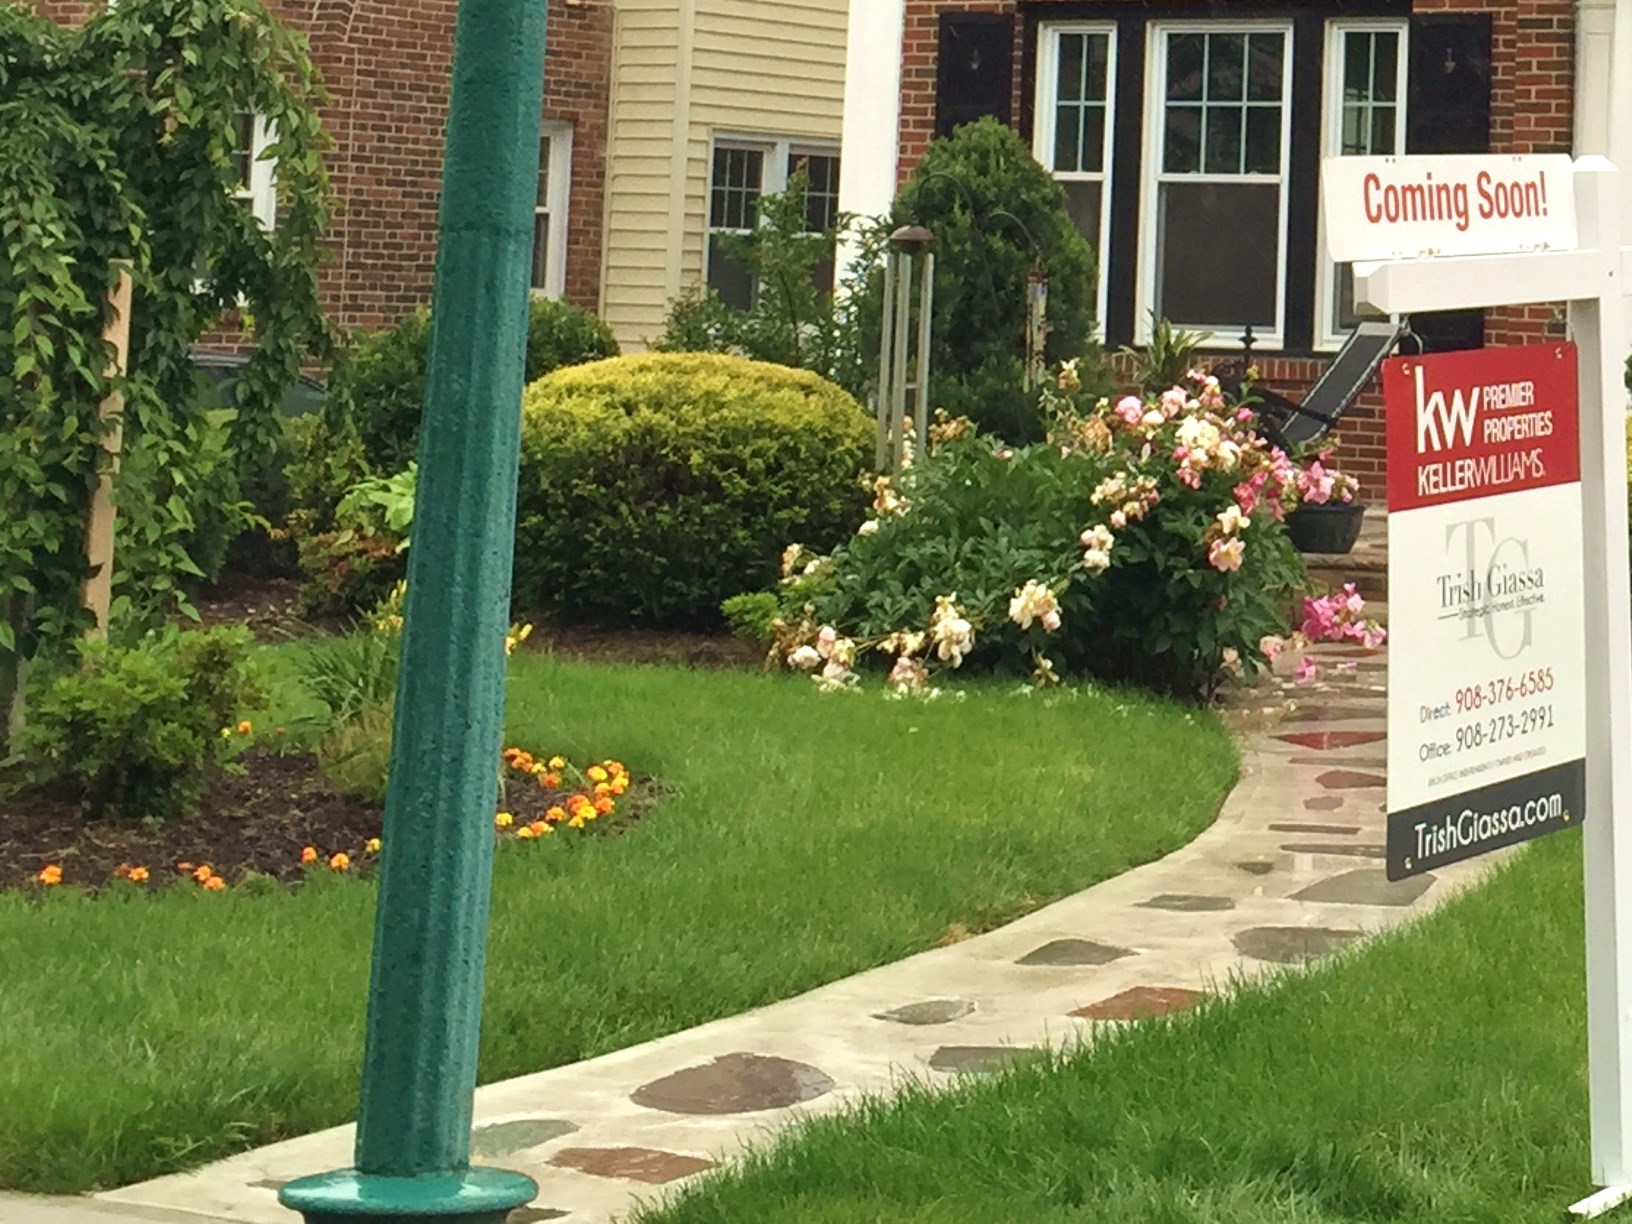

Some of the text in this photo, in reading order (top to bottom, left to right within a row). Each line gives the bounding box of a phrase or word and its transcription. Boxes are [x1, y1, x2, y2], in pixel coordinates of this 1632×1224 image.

[1363, 170, 1549, 232] Coming Soon!
[1414, 365, 1481, 454] kw
[1483, 380, 1535, 412] PREMIER
[1483, 409, 1554, 445] PROPERTIES
[1436, 563, 1545, 609] Trish Giassa
[1455, 666, 1554, 715] 908-376-6585
[1455, 704, 1554, 752] 908-273-2991
[1414, 792, 1563, 860] TrishGiassa.com
